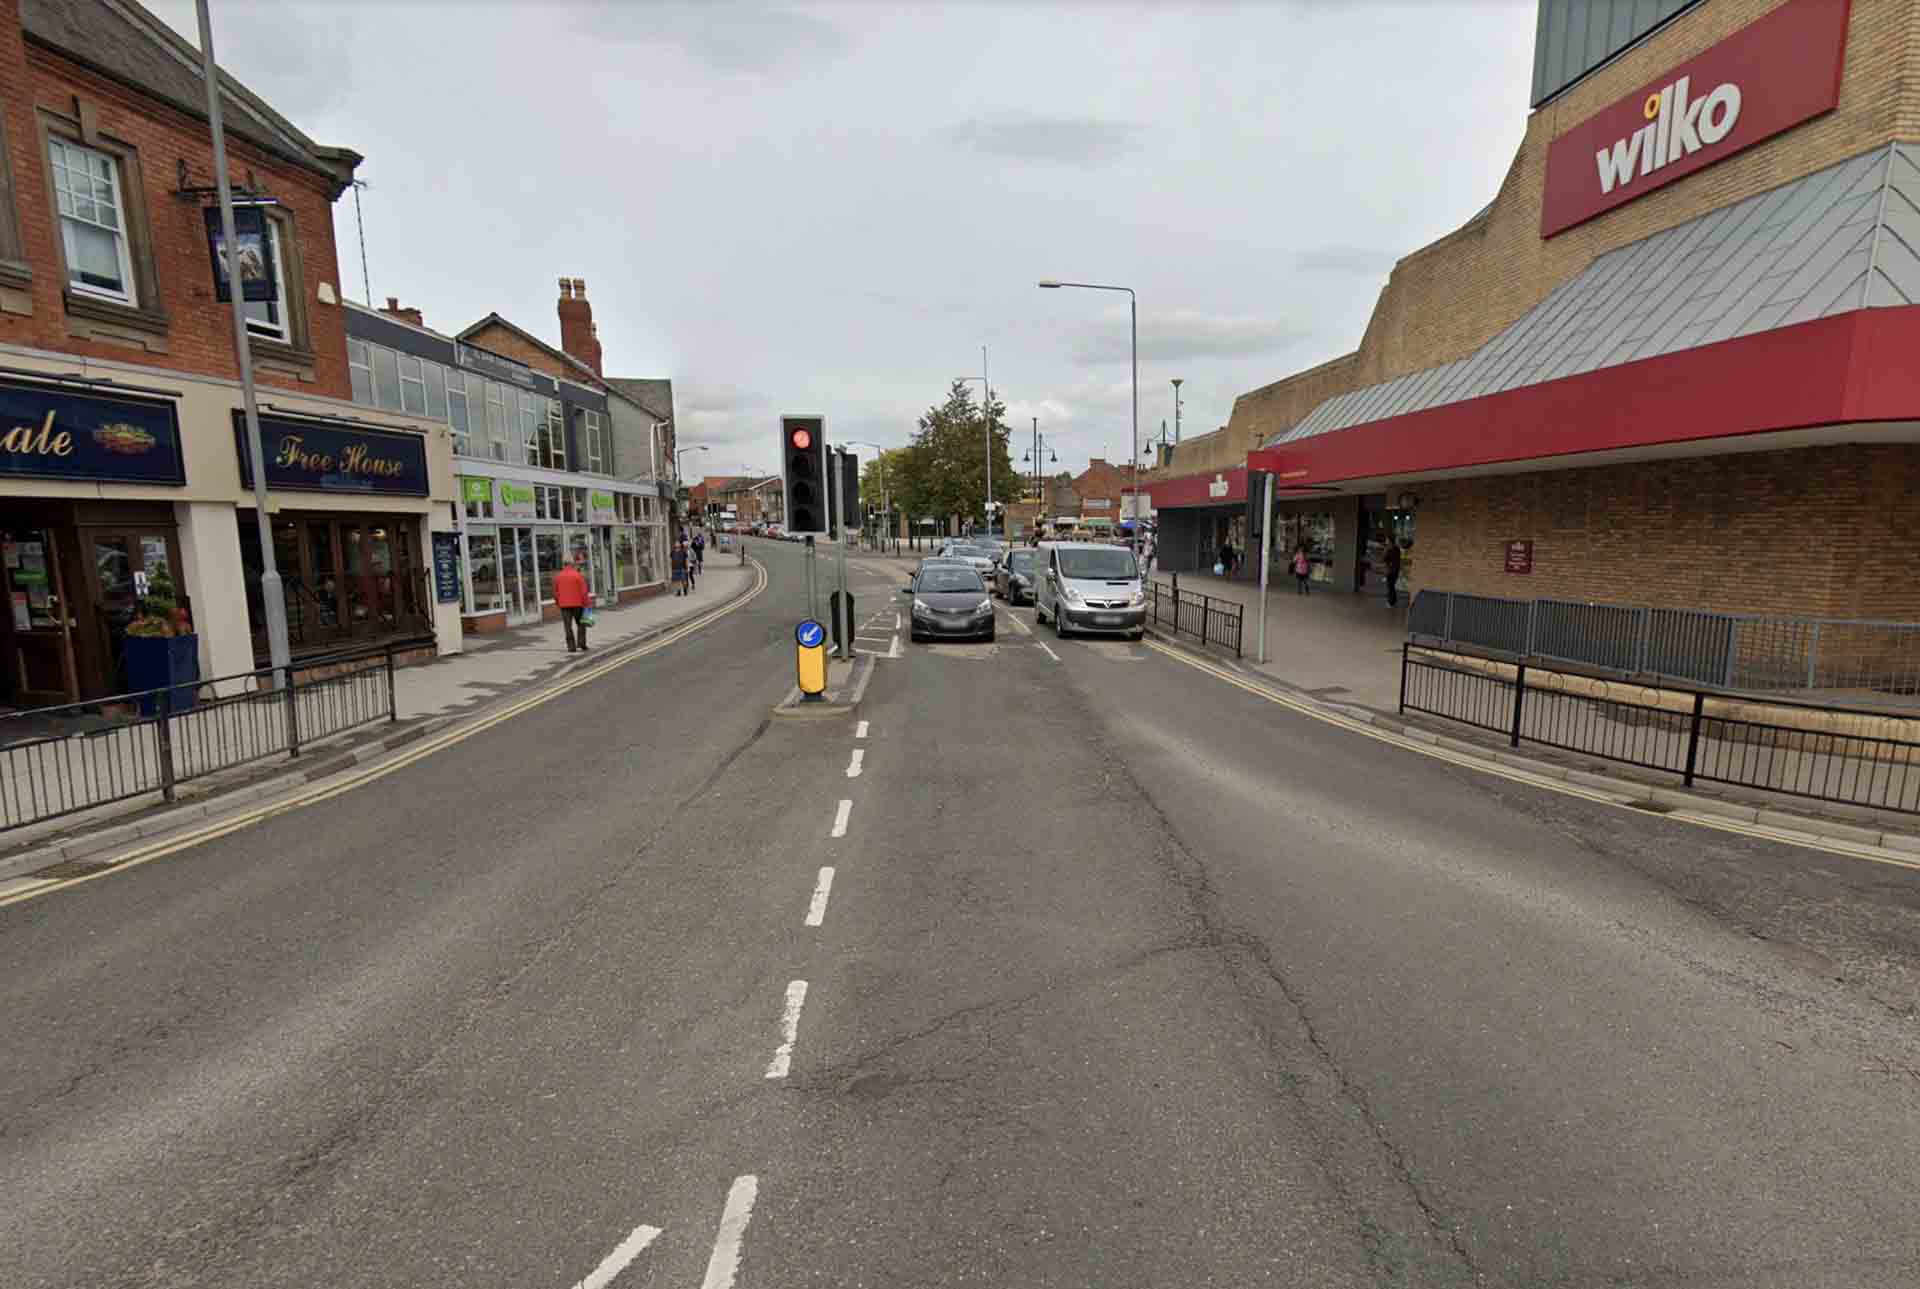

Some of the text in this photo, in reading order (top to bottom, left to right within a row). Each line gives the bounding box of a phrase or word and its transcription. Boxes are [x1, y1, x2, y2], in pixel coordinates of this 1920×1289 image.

[1596, 76, 1742, 194] wilko
[276, 436, 403, 478] Free House
